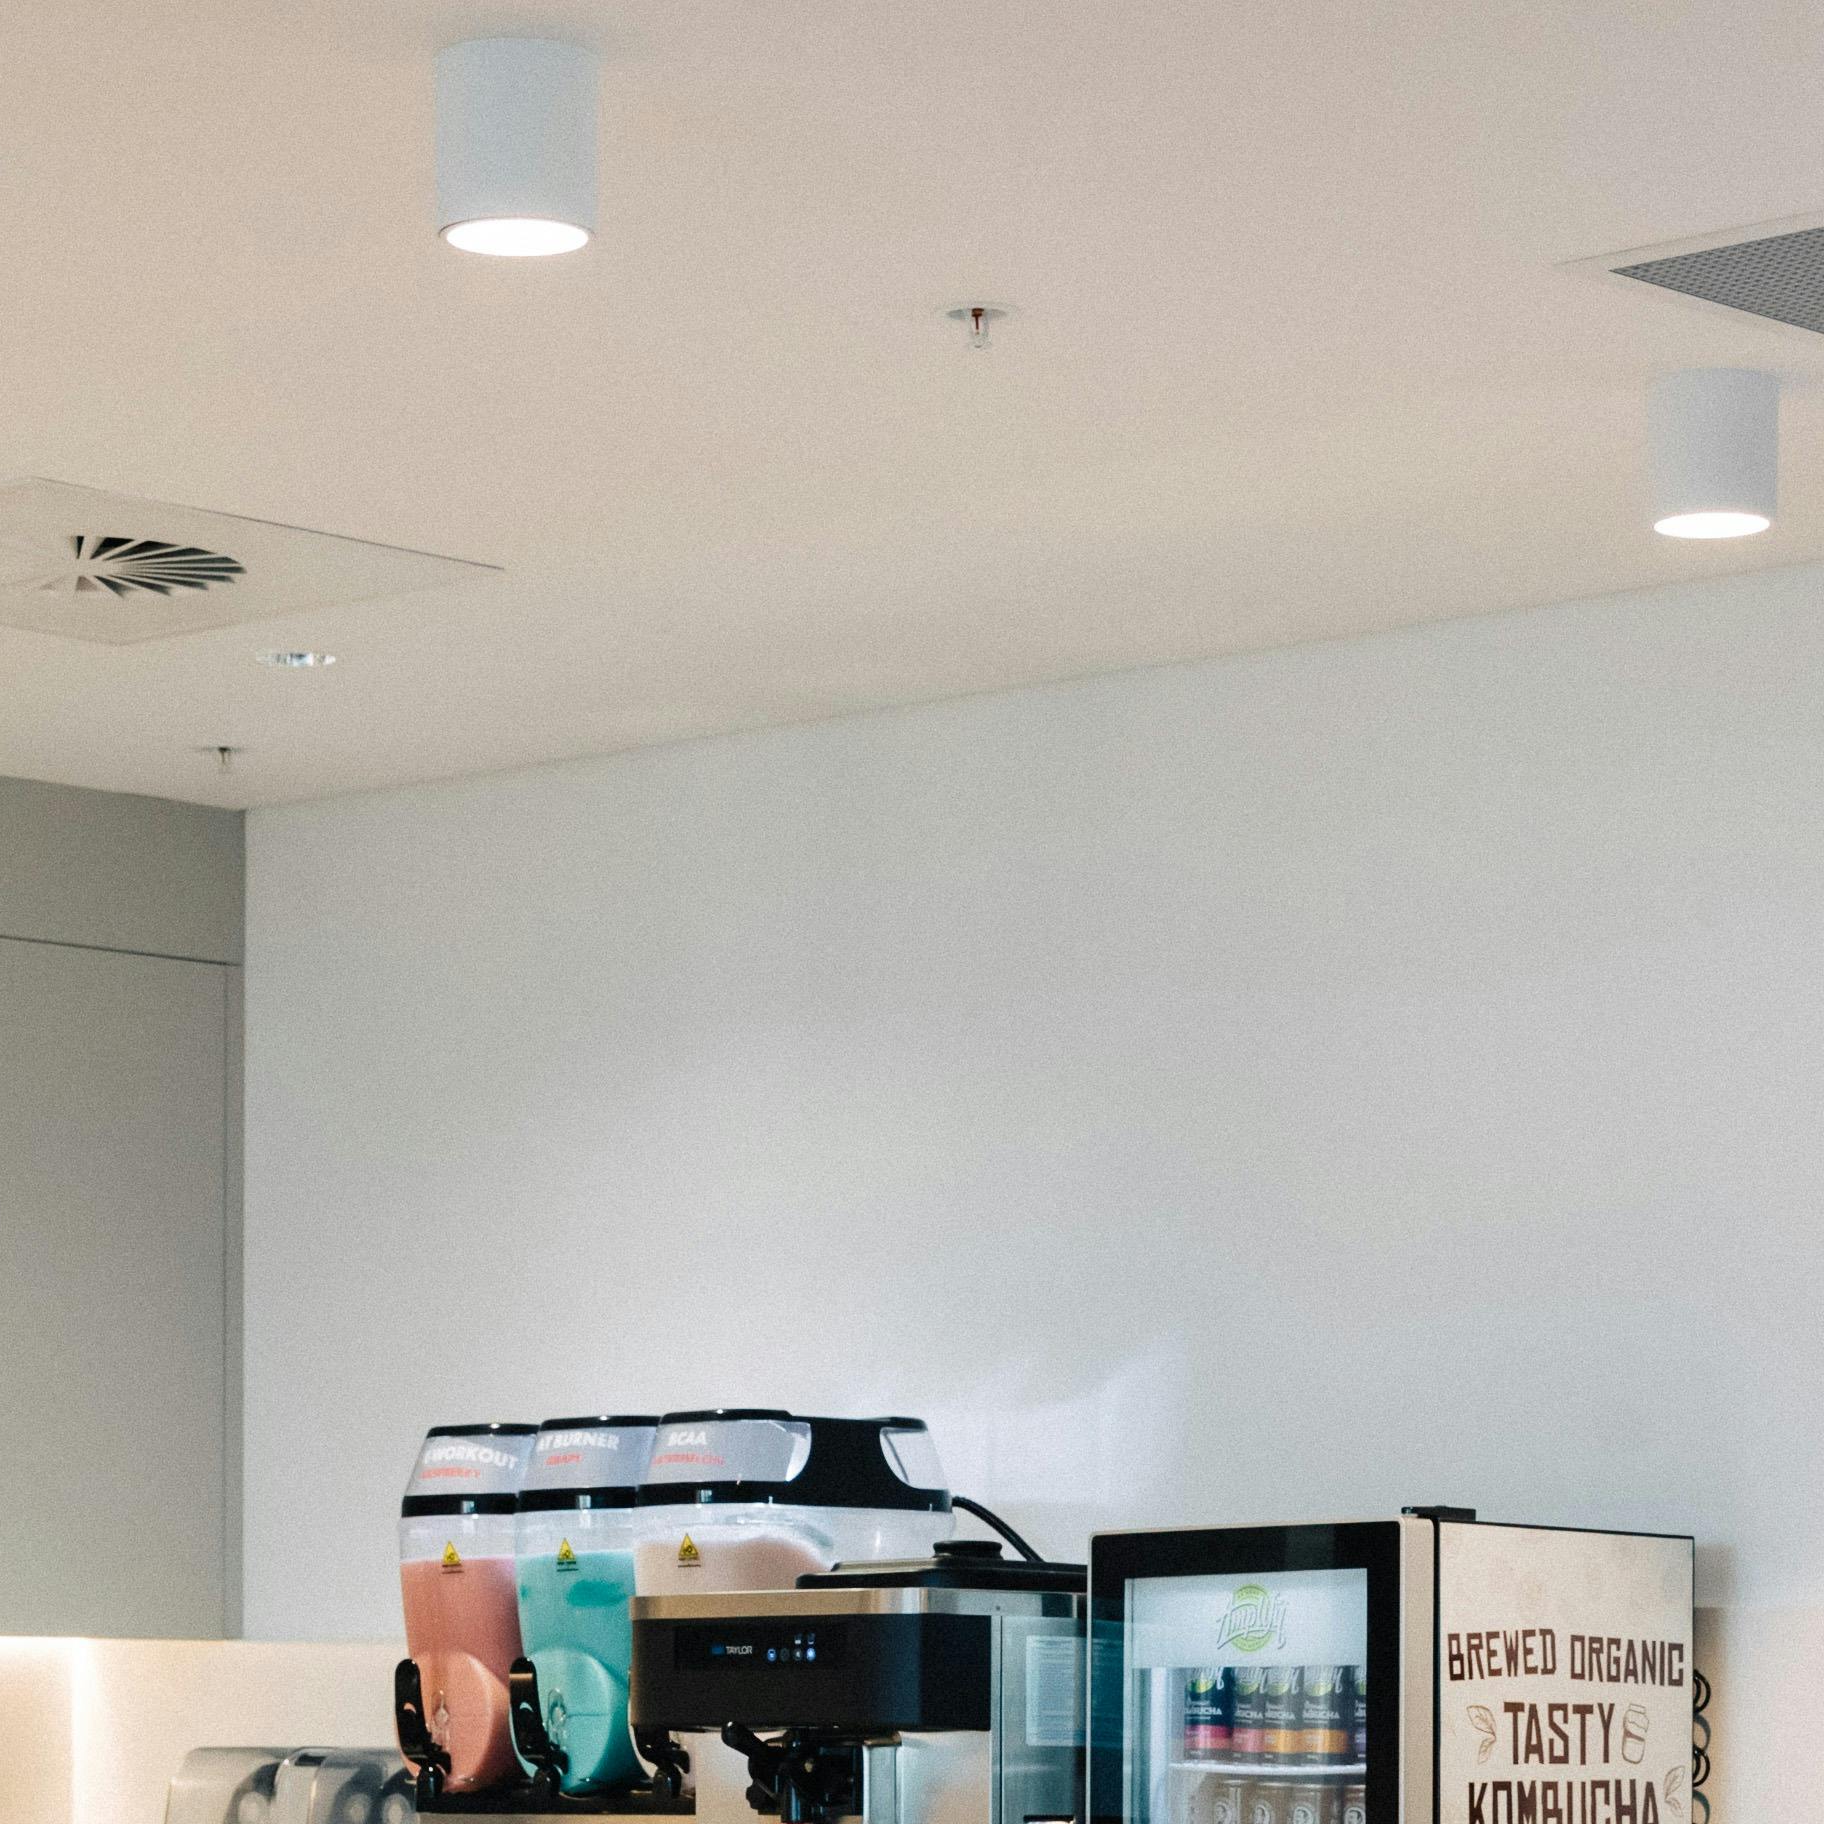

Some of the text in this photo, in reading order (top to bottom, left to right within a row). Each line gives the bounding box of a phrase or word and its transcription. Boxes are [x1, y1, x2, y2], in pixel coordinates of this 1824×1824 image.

[726, 1646, 752, 1655] TAYLOR
[1447, 1628, 1684, 1687] BREWED ORGANIC
[1503, 1701, 1615, 1765] TASTY
